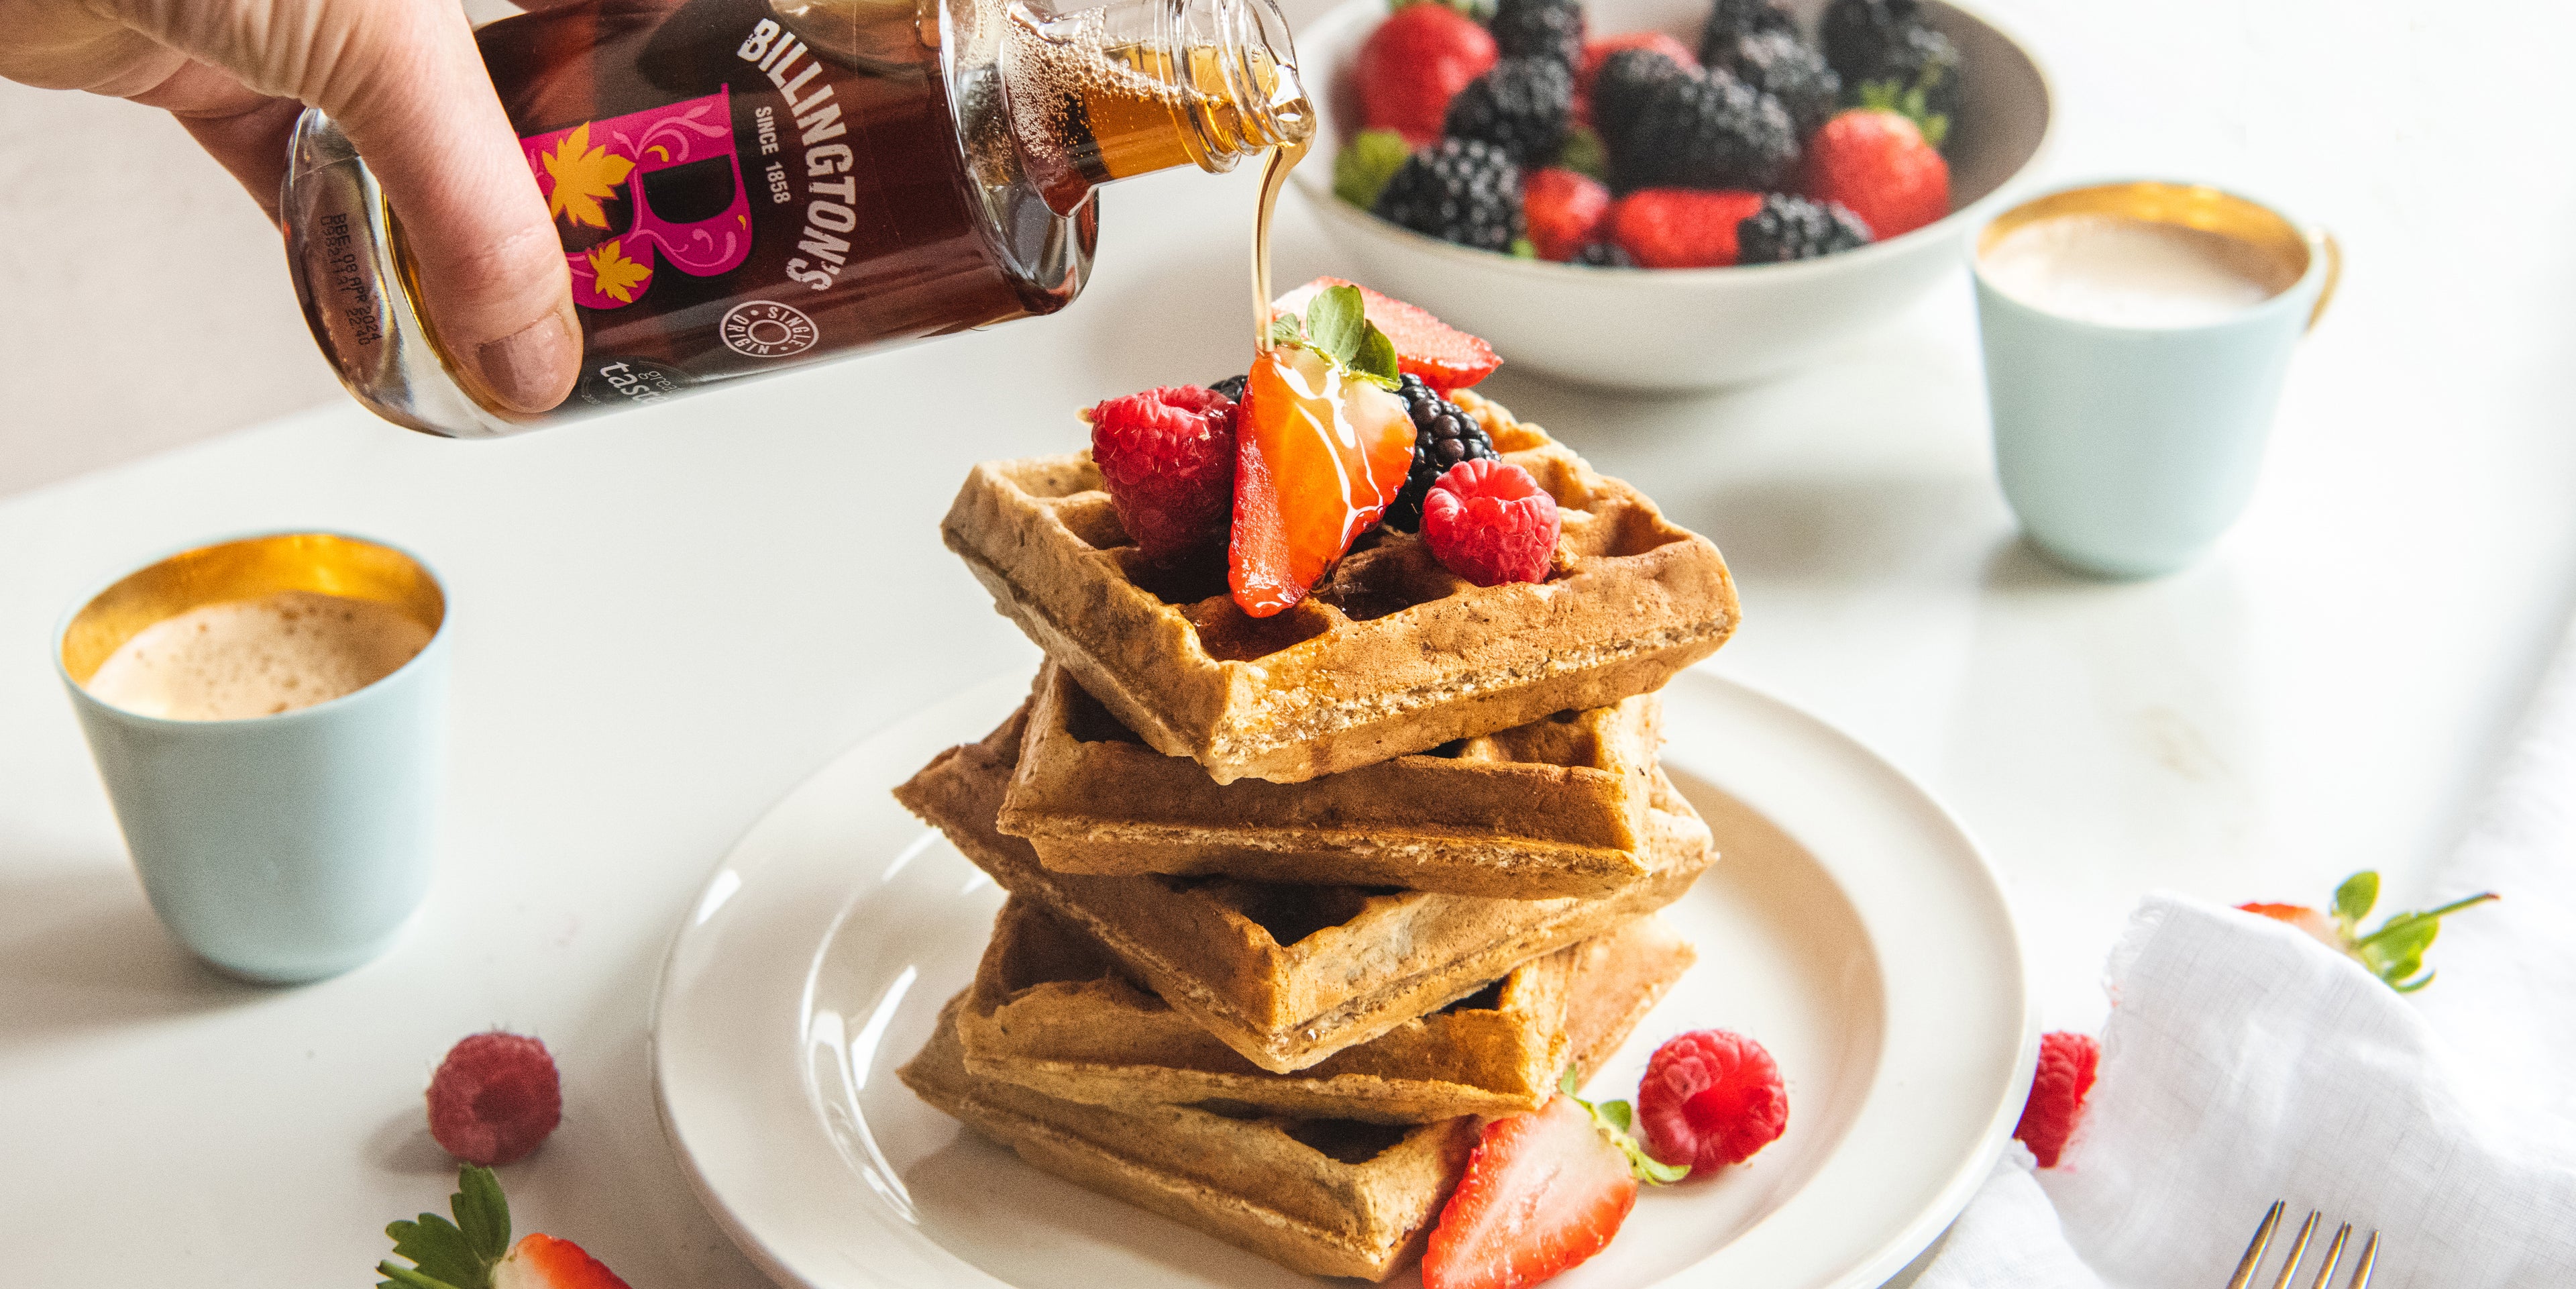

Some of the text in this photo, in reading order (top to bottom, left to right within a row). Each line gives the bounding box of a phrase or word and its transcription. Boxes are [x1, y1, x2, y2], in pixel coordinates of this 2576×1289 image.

[737, 17, 857, 291] BILLINGTON'S
[755, 105, 792, 204] SINCE 1858
[343, 253, 358, 274] 08
[347, 276, 368, 304] APR
[358, 305, 383, 341] 2024
[727, 313, 770, 354] ORIGIN
[767, 306, 812, 347] SINGLE
